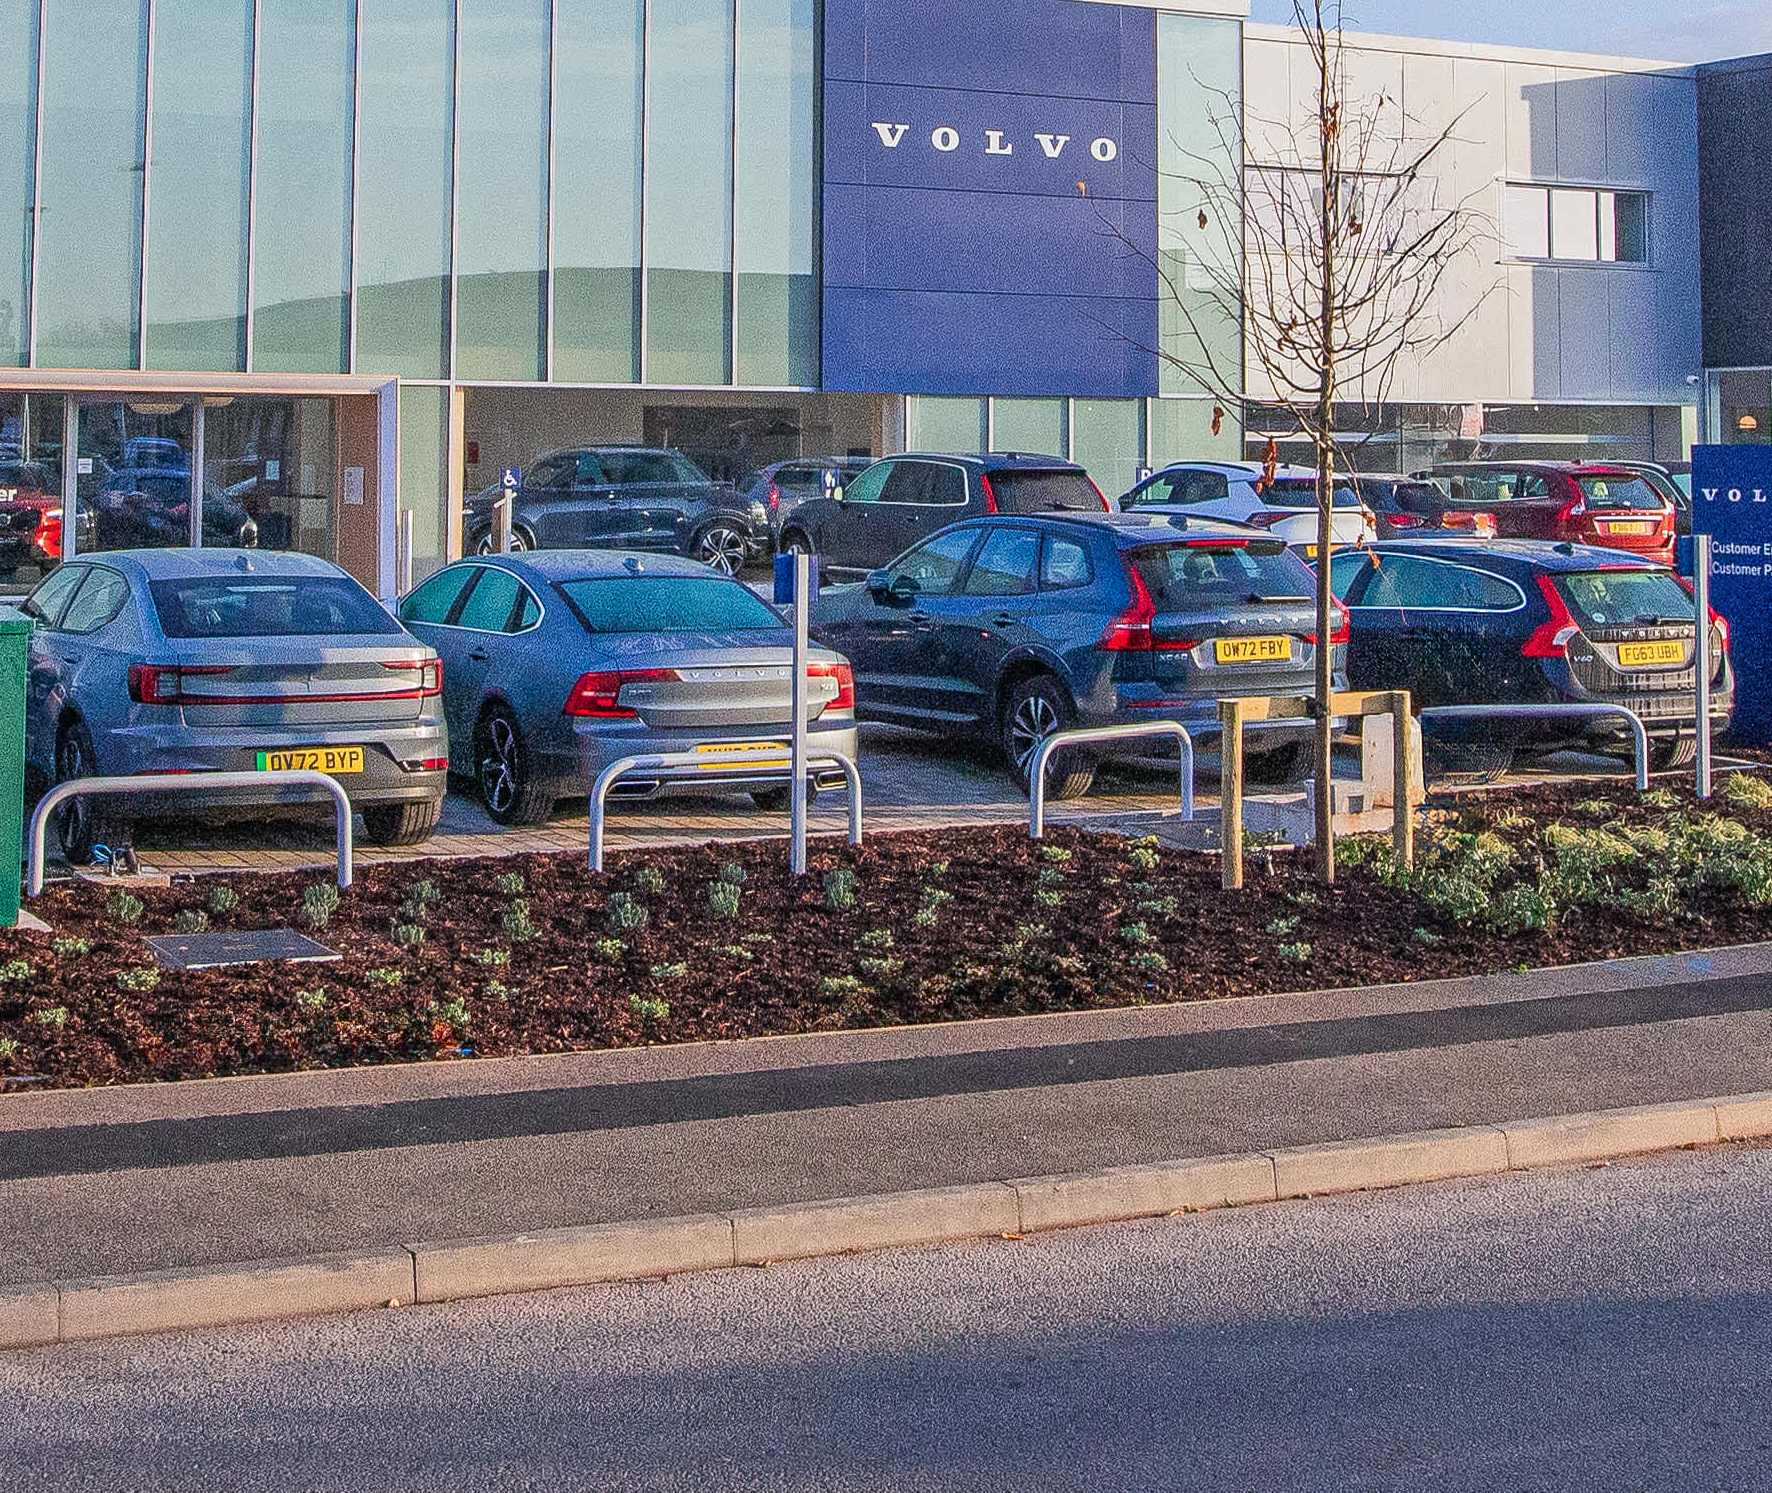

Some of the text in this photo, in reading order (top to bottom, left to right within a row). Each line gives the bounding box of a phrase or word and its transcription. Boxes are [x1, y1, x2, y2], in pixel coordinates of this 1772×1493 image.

[871, 122, 1118, 162] VOLVO
[1711, 541, 1761, 555] Customer
[1711, 561, 1761, 576] Customer
[324, 750, 360, 769] BYP
